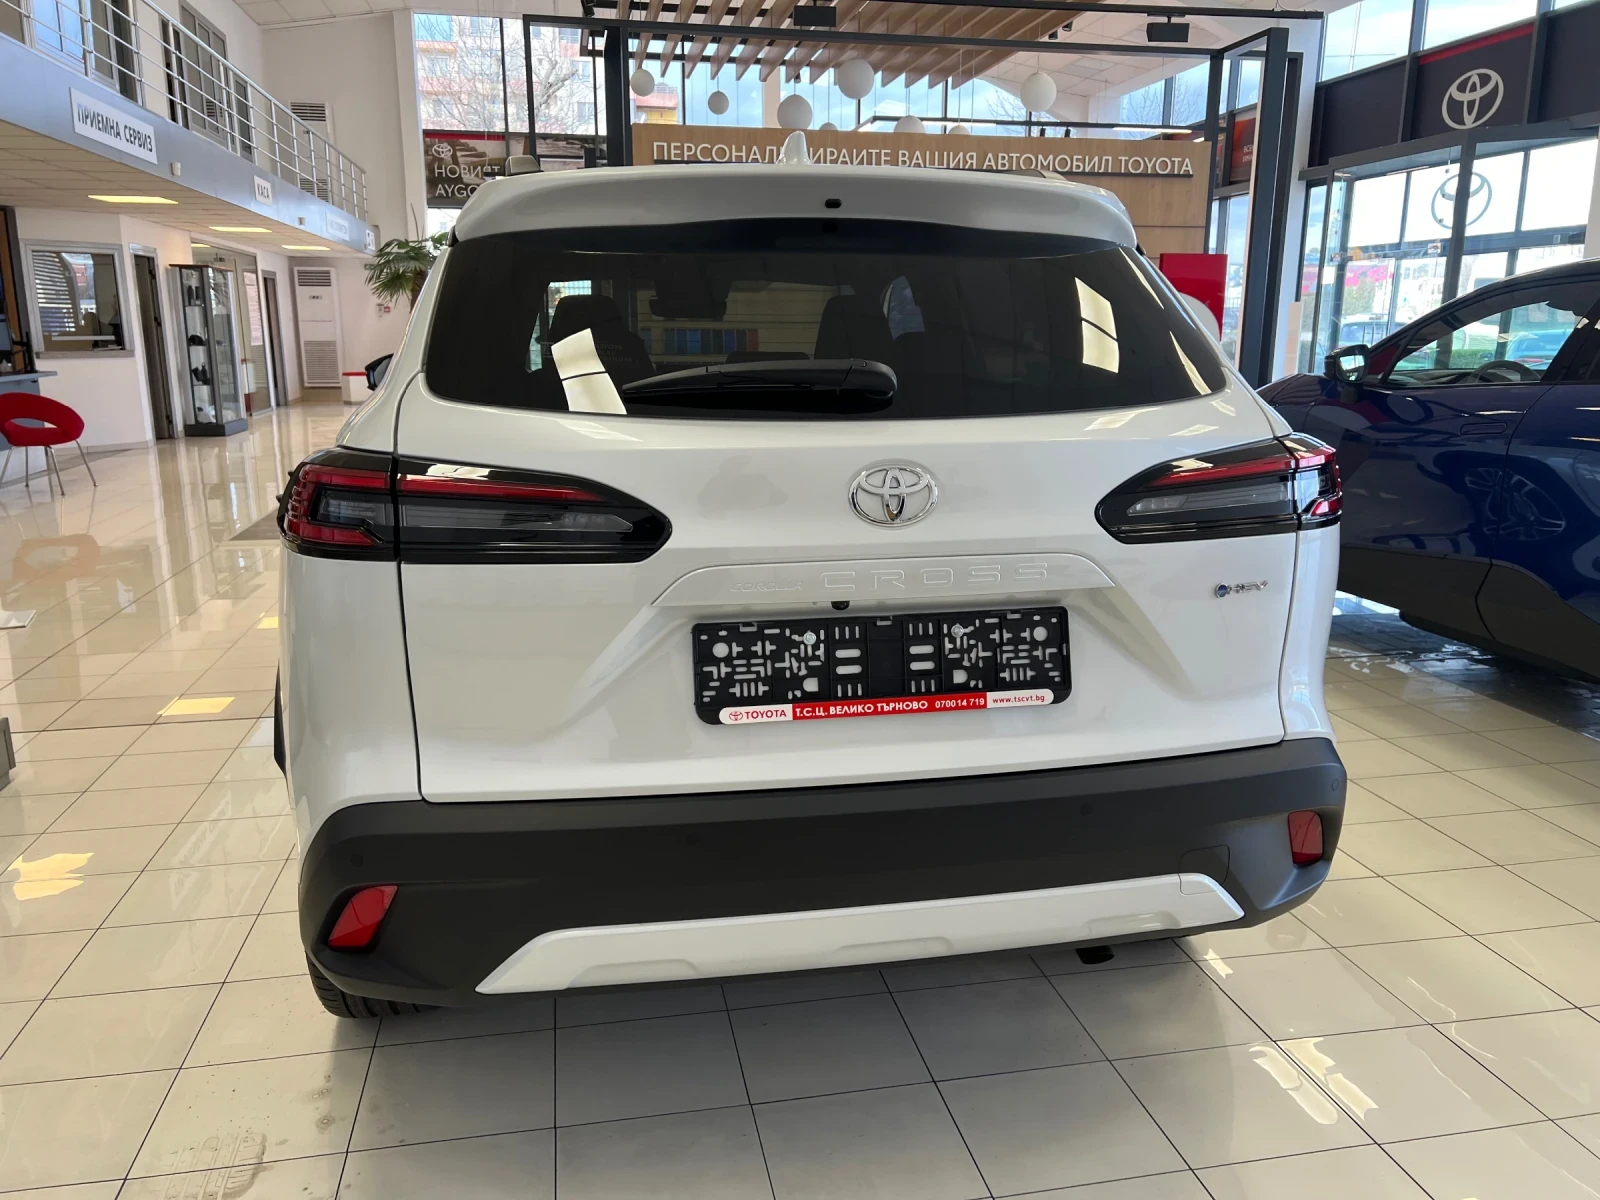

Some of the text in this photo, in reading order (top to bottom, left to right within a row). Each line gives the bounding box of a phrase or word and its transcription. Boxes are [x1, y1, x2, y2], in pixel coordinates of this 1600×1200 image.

[77, 102, 153, 153] ПРИЕМНА СЕРВИЗ
[898, 150, 977, 169] ВАШИЯ
[982, 153, 1113, 173] АВТОМОБИЛ
[1118, 156, 1194, 175] TOYOTA
[729, 563, 1048, 593] COROLLA CROSS
[744, 709, 787, 720] TOYOTA
[829, 703, 874, 715] ВЕЛИКО
[876, 700, 928, 712] ТЪРНОВО
[969, 698, 985, 706] 719
[992, 694, 1045, 704] www.tscvt.bg
